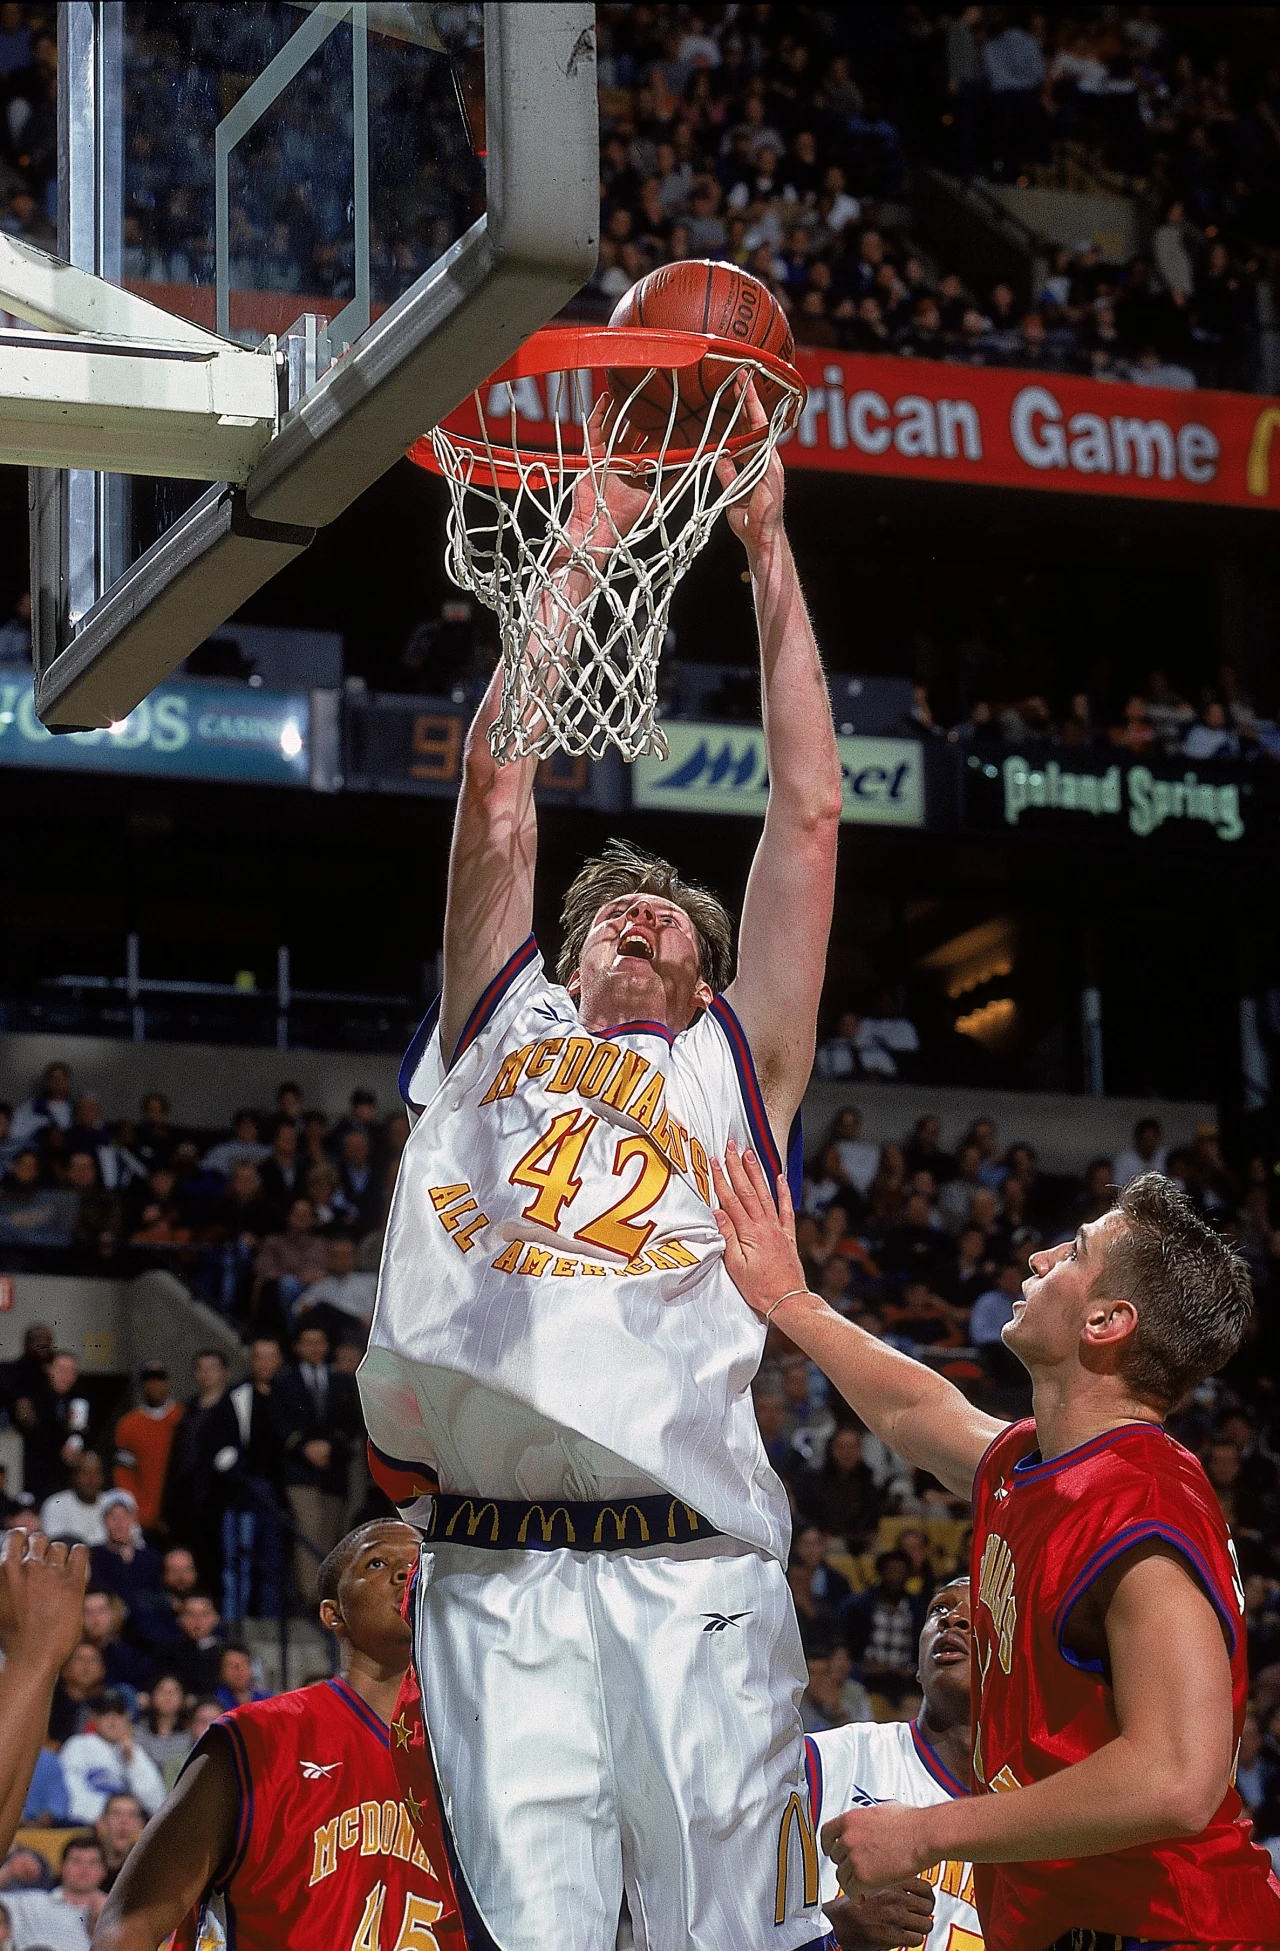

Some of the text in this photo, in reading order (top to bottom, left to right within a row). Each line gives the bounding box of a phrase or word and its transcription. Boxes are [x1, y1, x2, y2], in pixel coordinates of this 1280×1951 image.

[776, 364, 982, 462] rican
[1010, 385, 1220, 484] Game
[1127, 765, 1245, 841] Spring
[427, 1183, 490, 1254] ALL
[508, 1107, 671, 1264] 42
[351, 1880, 443, 1951] 45
